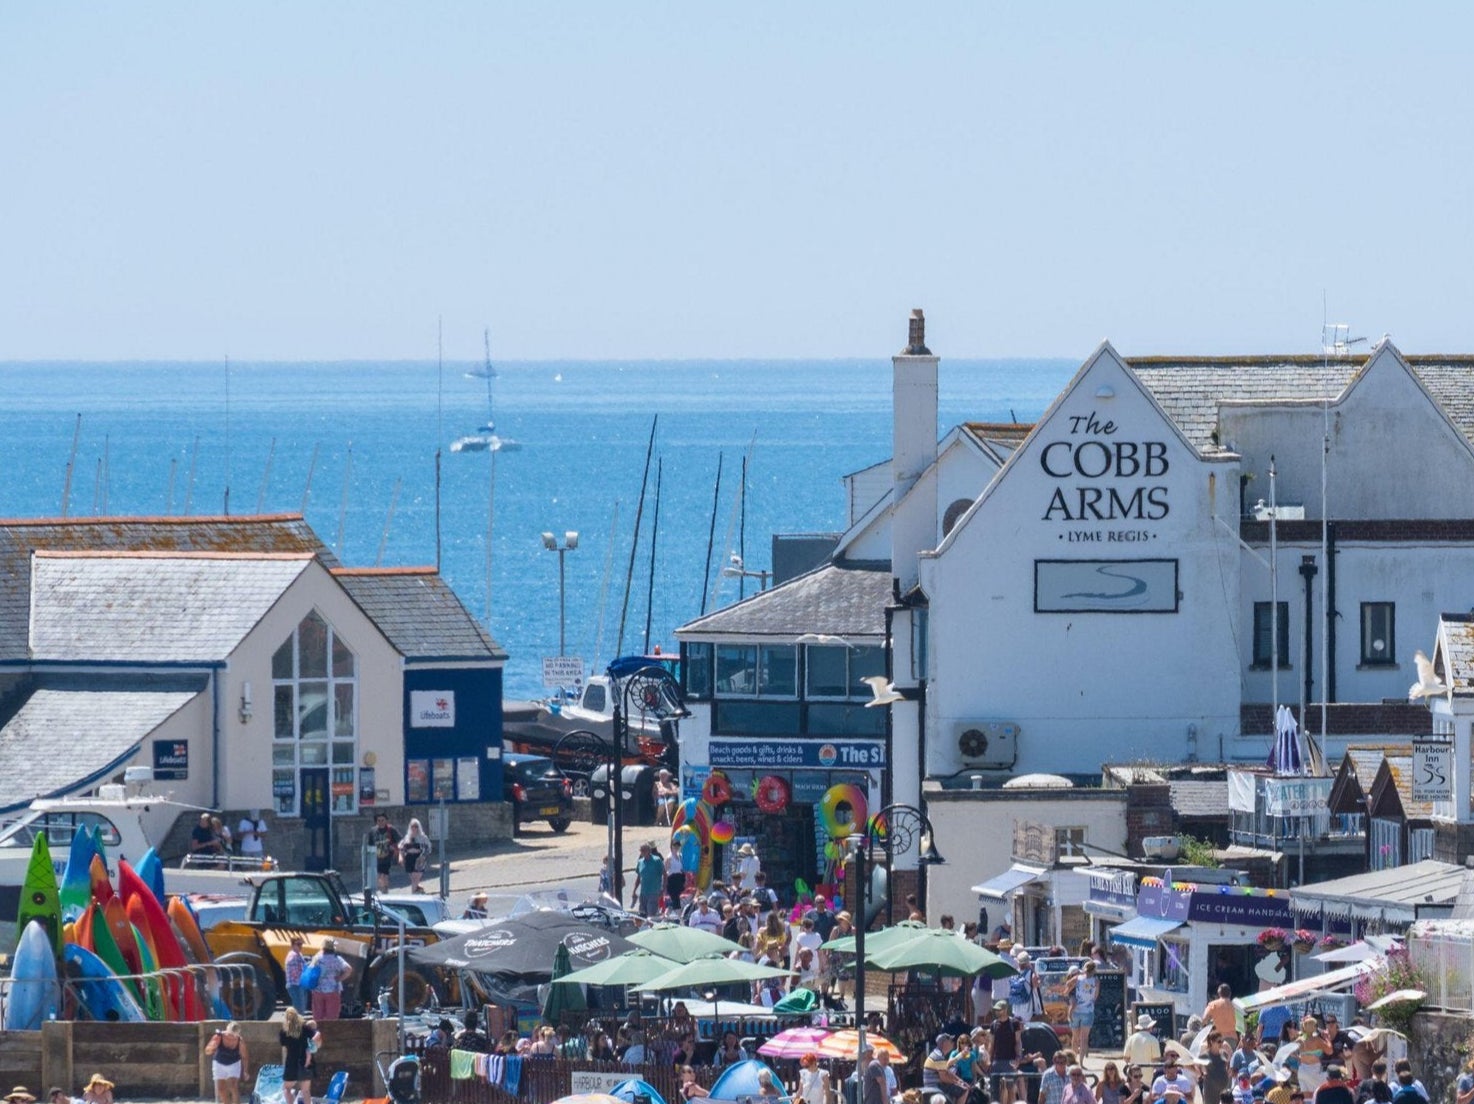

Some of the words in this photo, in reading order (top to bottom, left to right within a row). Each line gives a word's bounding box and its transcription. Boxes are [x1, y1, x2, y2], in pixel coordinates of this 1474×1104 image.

[1069, 411, 1118, 435] The
[1040, 441, 1169, 478] COBB
[1041, 486, 1170, 520] ARMS
[1068, 531, 1102, 542] LYME
[1108, 531, 1149, 542] REGIS
[710, 745, 730, 754] Beach
[732, 746, 751, 756] goods
[776, 746, 796, 754] drinks
[841, 746, 868, 763] The
[1415, 745, 1449, 753] Harbour
[1425, 754, 1440, 762] Inn
[1196, 904, 1210, 912] ICE
[1215, 905, 1244, 914] CREAM
[1249, 908, 1295, 918] HANDMAD
